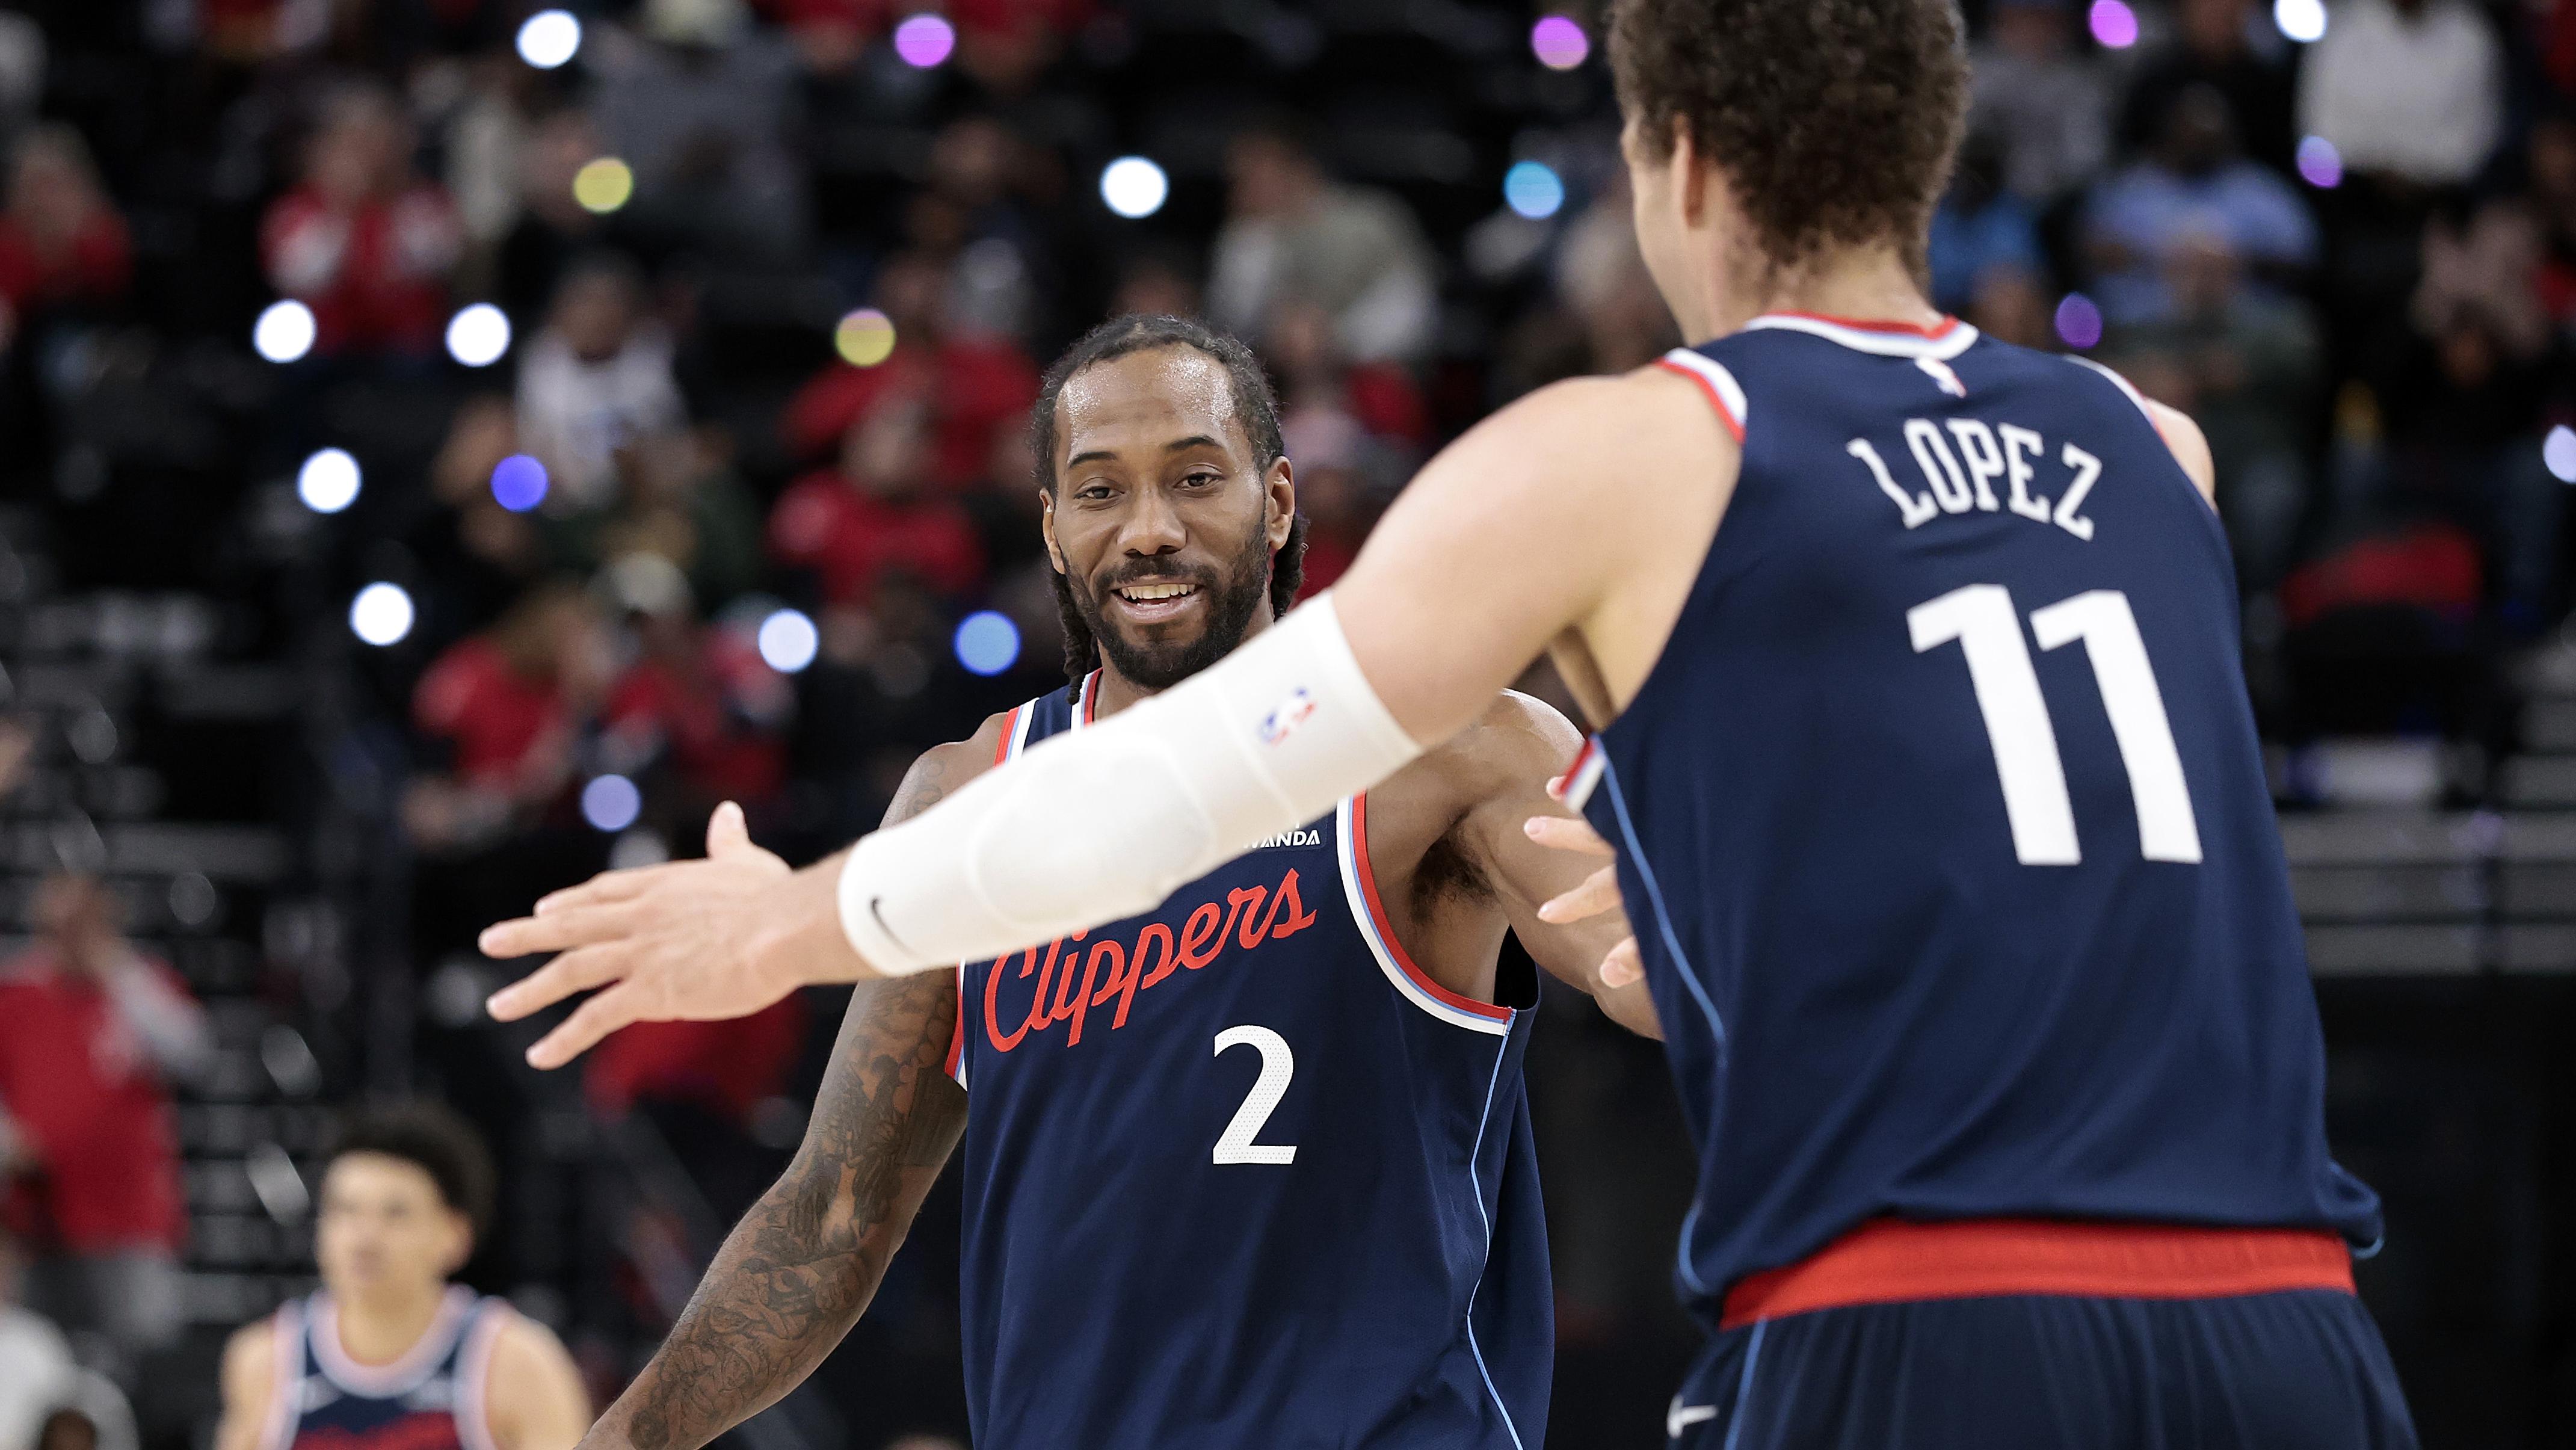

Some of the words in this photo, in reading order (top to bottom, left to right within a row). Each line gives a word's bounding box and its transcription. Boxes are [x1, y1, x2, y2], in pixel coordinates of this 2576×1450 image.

[1846, 418, 2102, 541] LOPEZ
[1906, 583, 2203, 866] 11
[984, 868, 1317, 1052] Clippers
[1213, 1025, 1297, 1165] 2
